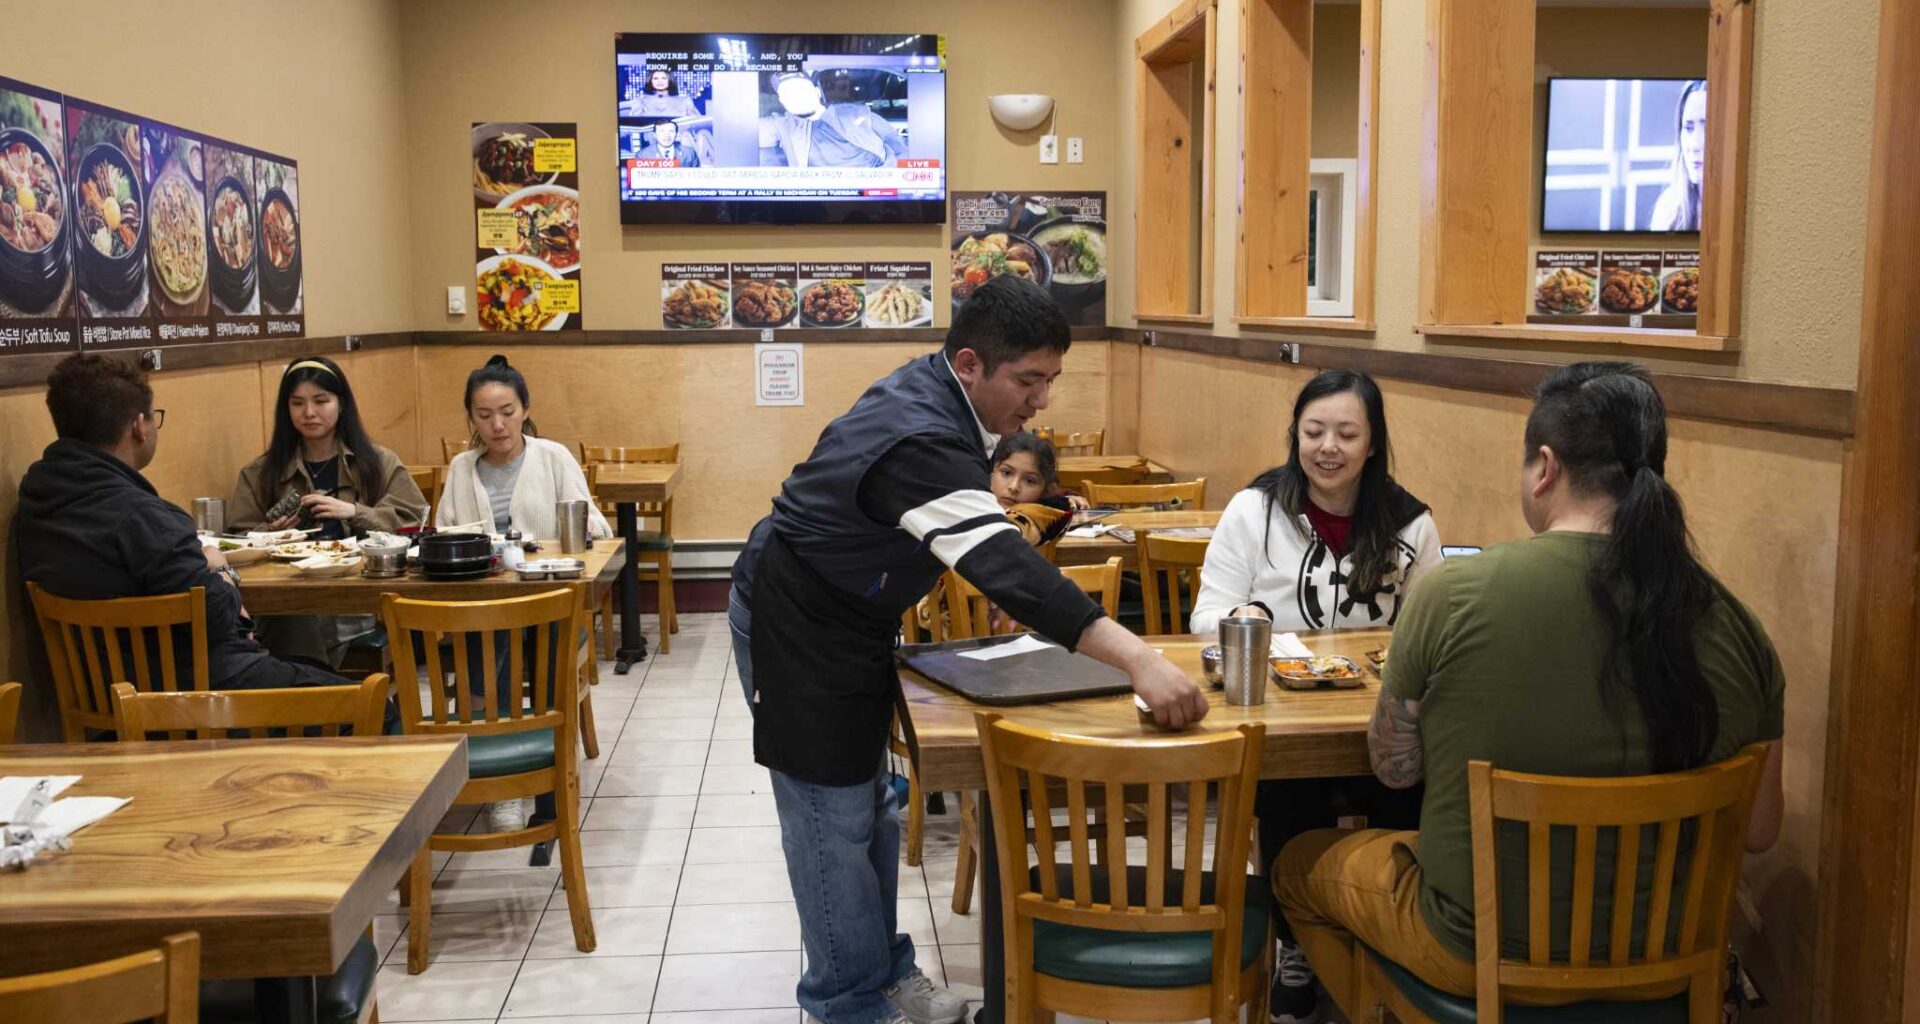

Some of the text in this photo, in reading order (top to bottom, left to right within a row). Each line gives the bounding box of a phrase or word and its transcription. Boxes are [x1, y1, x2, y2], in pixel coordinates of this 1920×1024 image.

[637, 170, 661, 178] TRUMP
[821, 170, 842, 178] FROM
[855, 170, 893, 178] SALVADOR
[903, 171, 933, 182] CNN
[664, 265, 725, 273] Original Fried Chicken
[889, 265, 909, 273] Squid
[25, 327, 39, 344] Soft
[39, 327, 53, 344] Tofu
[53, 327, 70, 345] Soup
